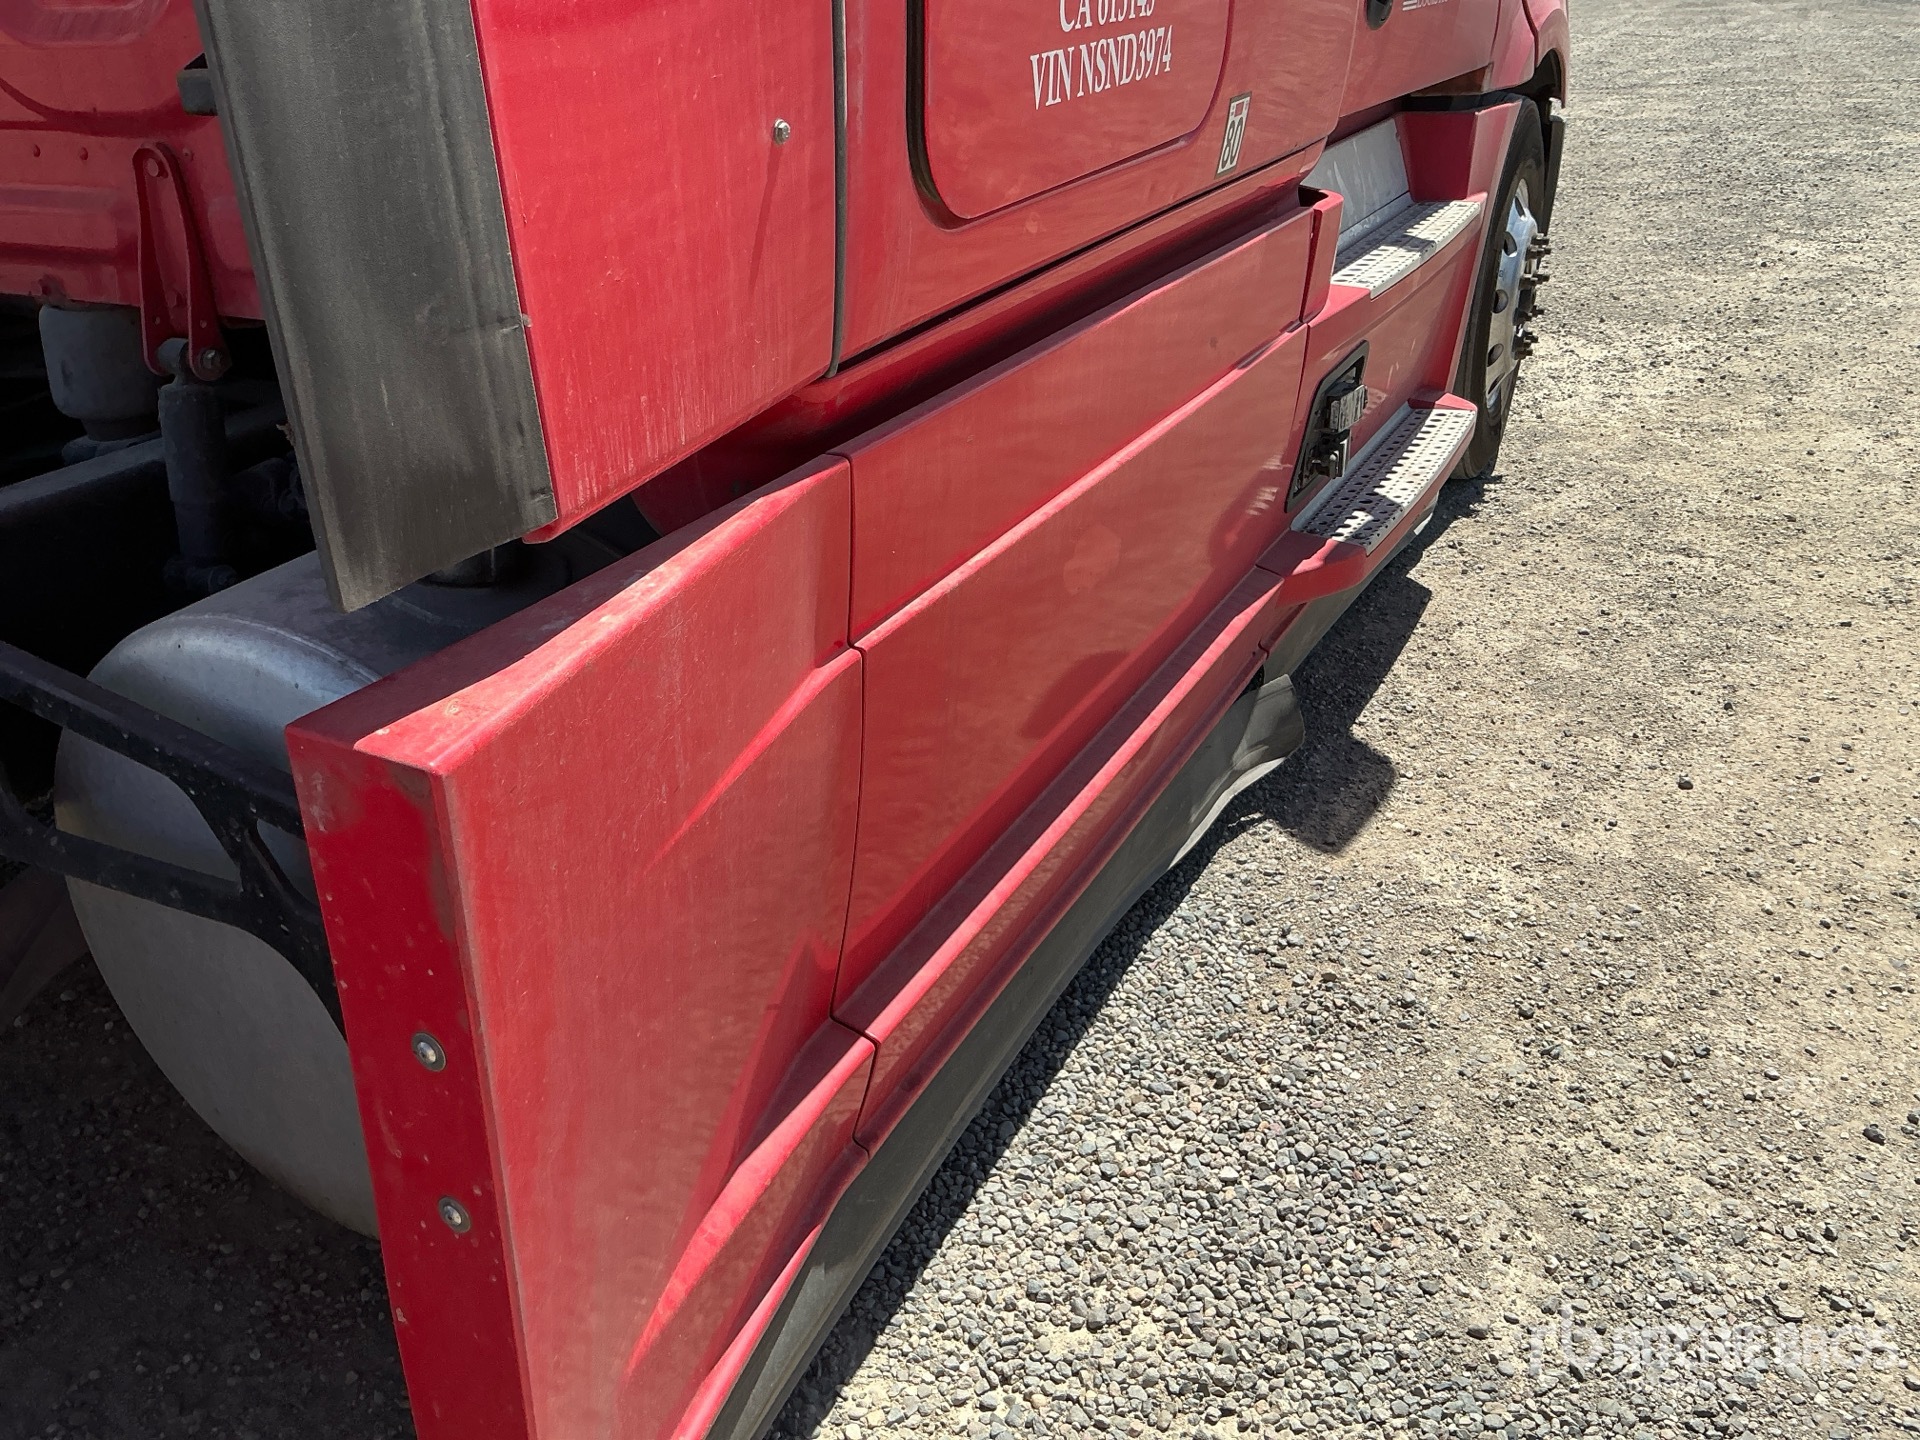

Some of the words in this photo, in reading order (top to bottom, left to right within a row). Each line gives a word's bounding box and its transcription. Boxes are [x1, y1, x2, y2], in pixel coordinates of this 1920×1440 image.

[1059, 0, 1093, 33] CA
[1030, 46, 1075, 111] VIN
[1077, 25, 1173, 98] NSND3974
[1221, 116, 1244, 169] 80
